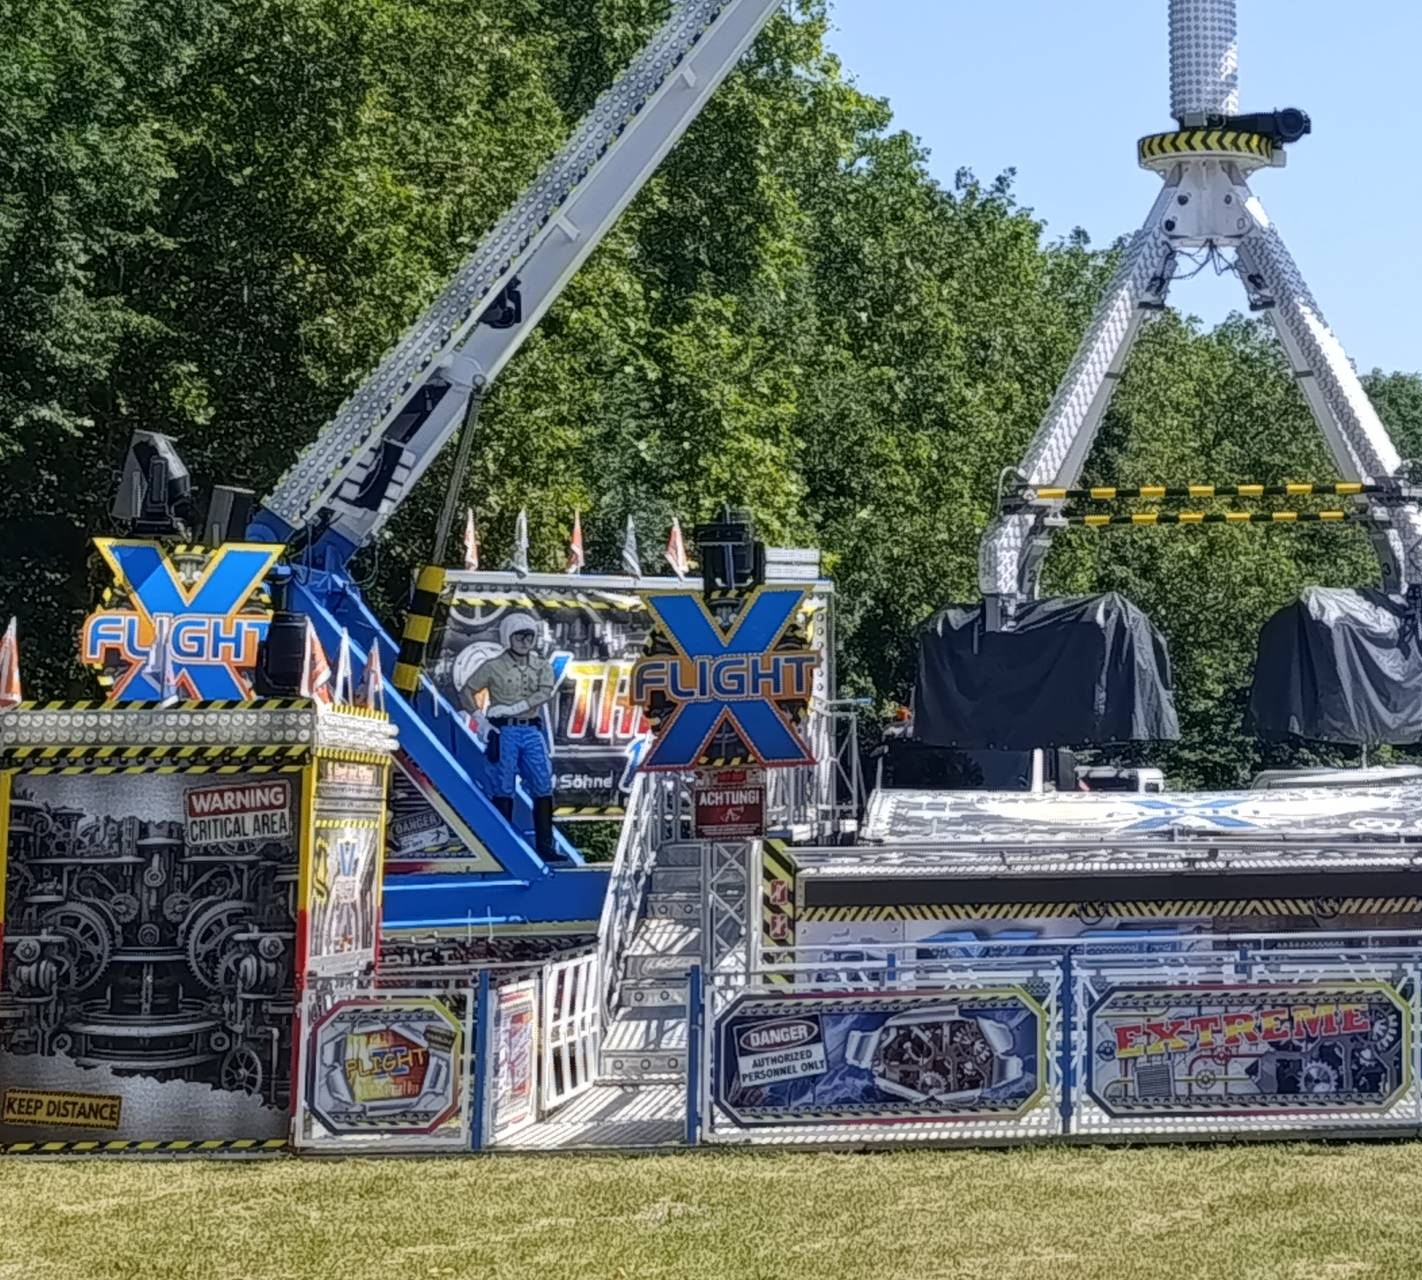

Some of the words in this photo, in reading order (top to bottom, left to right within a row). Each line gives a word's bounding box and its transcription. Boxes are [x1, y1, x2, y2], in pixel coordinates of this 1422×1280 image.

[634, 653, 818, 700] FLIGHT
[559, 772, 613, 789] Söhne
[191, 786, 284, 813] WARNING
[190, 815, 249, 841] CRITICAL
[253, 811, 288, 836] AREA
[750, 1025, 808, 1047] DANGER
[1114, 1003, 1371, 1059] EXTREME
[752, 1049, 812, 1068] AUTHORIZED
[742, 1065, 798, 1082] PERSONNEL
[801, 1060, 825, 1072] ONLY
[6, 1097, 44, 1116] KEEP
[46, 1100, 118, 1121] DISTANCE
